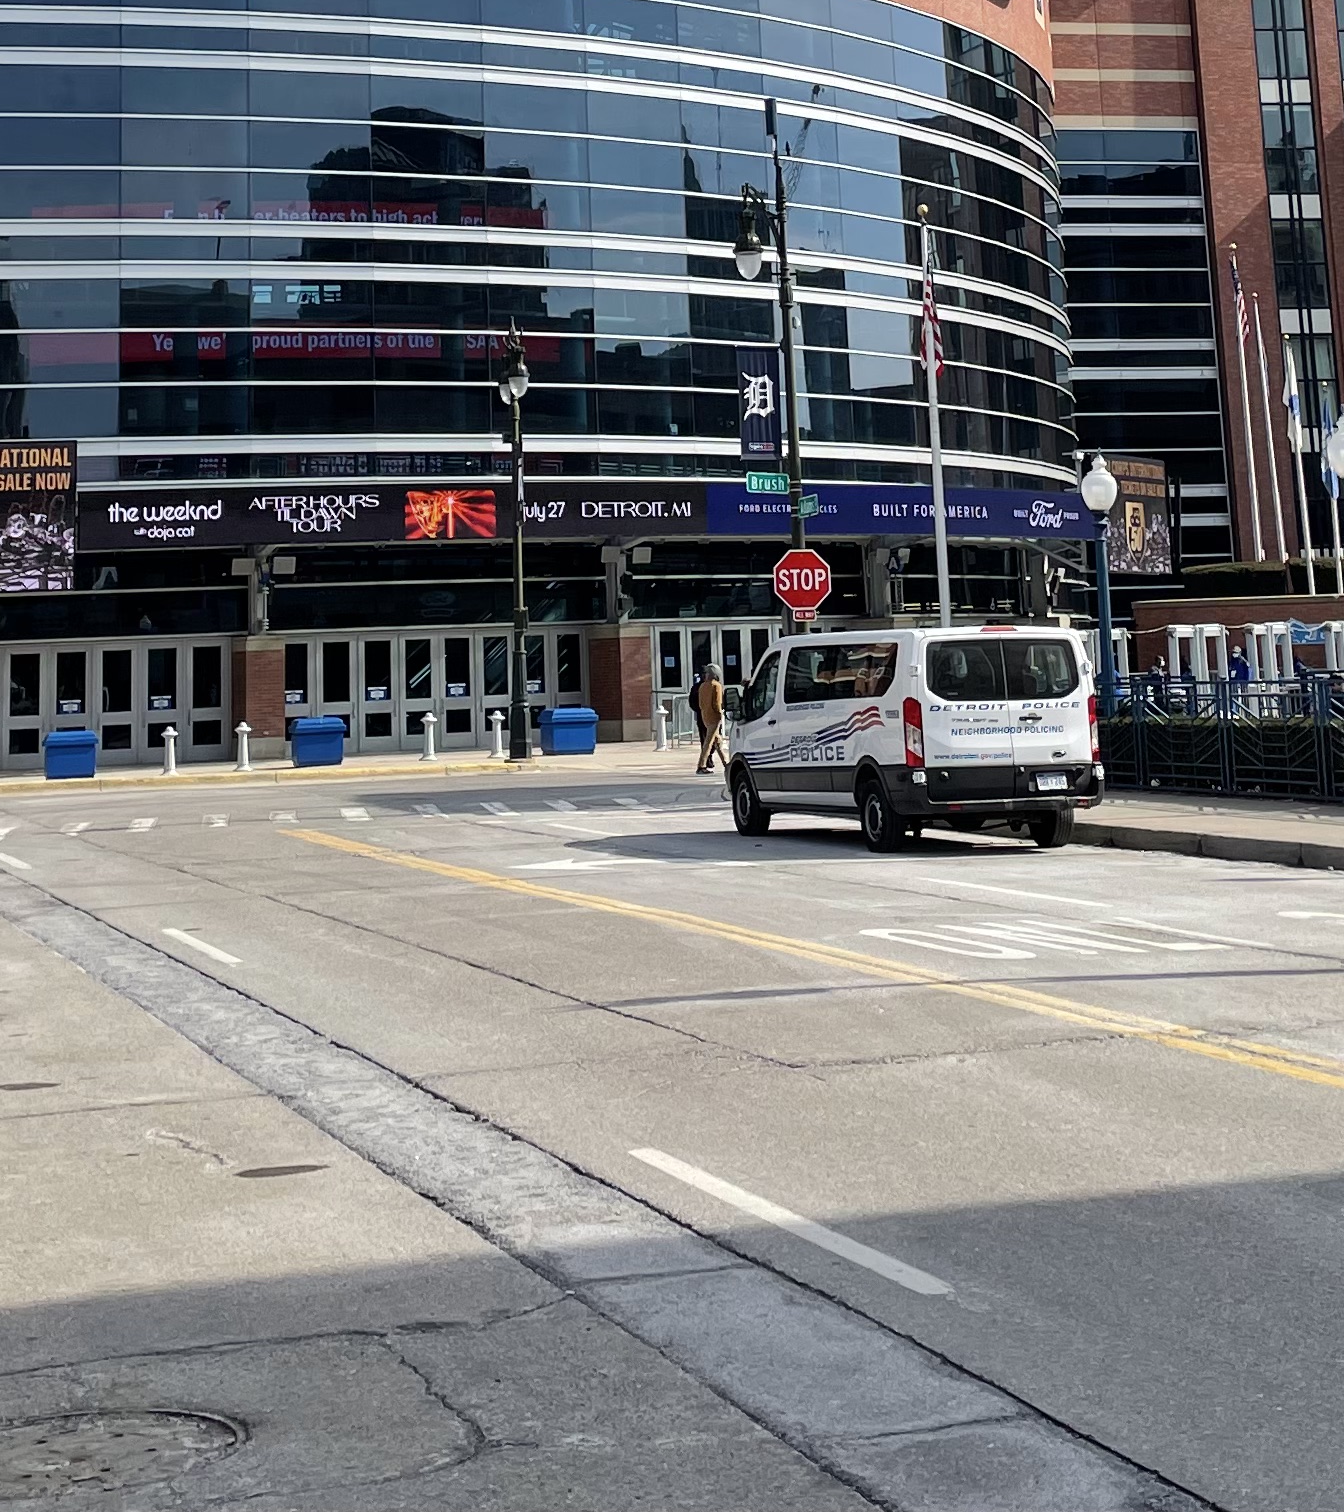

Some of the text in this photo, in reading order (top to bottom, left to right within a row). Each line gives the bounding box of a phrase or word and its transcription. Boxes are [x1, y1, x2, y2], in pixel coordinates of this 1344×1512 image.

[253, 332, 303, 352] proud
[387, 332, 404, 348] of
[407, 332, 435, 350] the
[35, 473, 71, 490] NOW
[751, 475, 785, 491] Brush
[249, 494, 380, 510] AFTER HOURS
[548, 501, 566, 518] 27
[671, 501, 692, 517] MI
[739, 504, 761, 513] FORD
[763, 504, 792, 513] ELECTR
[108, 500, 222, 523] the weeknd
[301, 507, 356, 521] DAWN
[873, 504, 907, 517] BUILT
[913, 504, 935, 517] FOR
[1029, 500, 1063, 529] Ford
[147, 525, 175, 541] doja
[176, 526, 195, 537] cat
[291, 519, 342, 533] TOUR
[778, 568, 826, 591] STOP
[929, 701, 1081, 712] DETROIT POLICE
[950, 725, 1064, 736] NEIGHBORHOOD POLICING
[790, 746, 845, 762] POLICE
[857, 916, 1274, 960] ONLY
